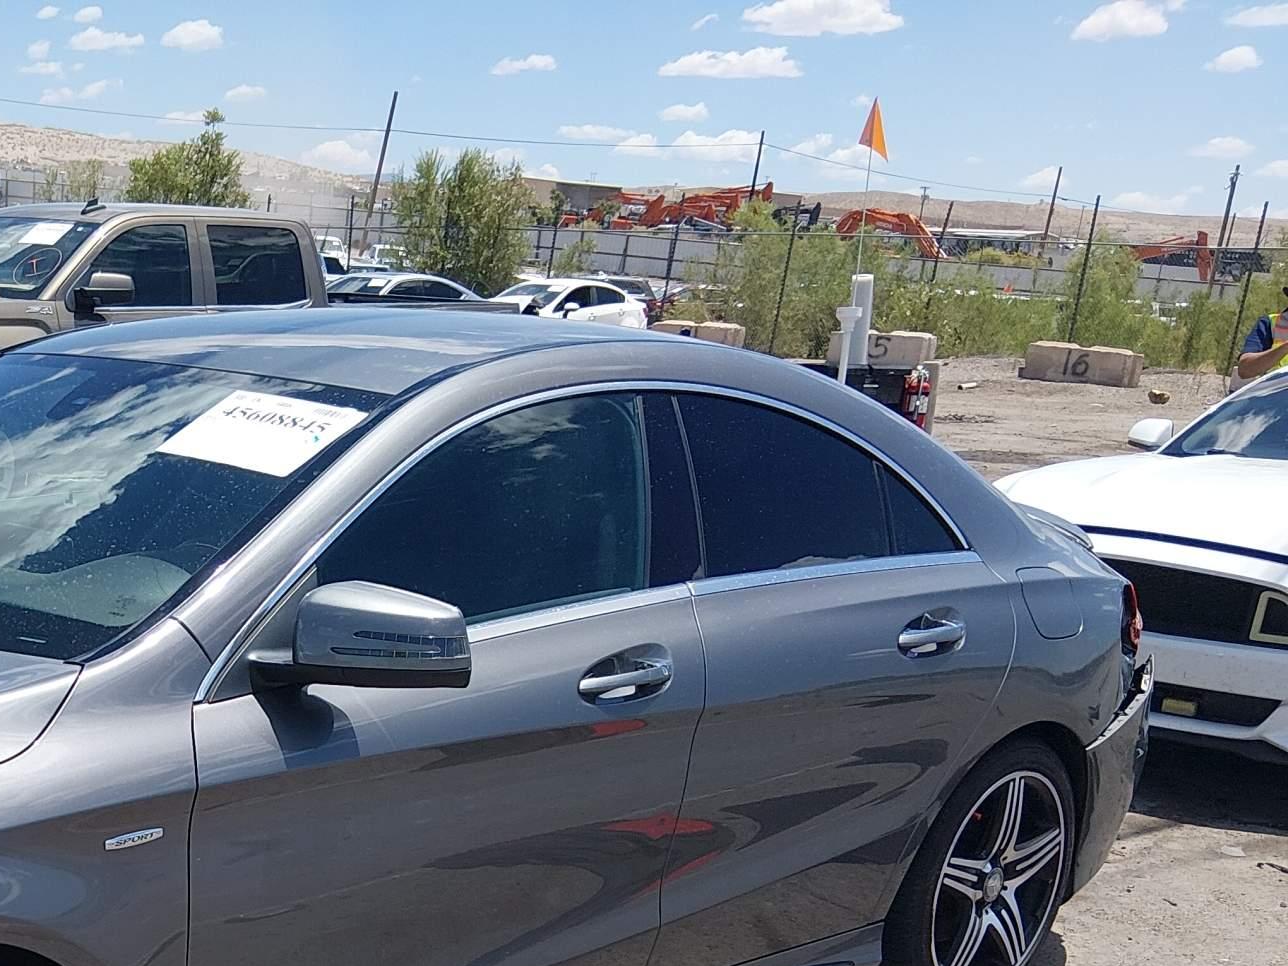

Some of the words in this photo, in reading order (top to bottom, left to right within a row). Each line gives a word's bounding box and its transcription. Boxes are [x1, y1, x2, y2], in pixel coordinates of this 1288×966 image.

[1062, 349, 1090, 377] 16
[222, 405, 333, 434] 45608845
[114, 831, 154, 847] SPORT
